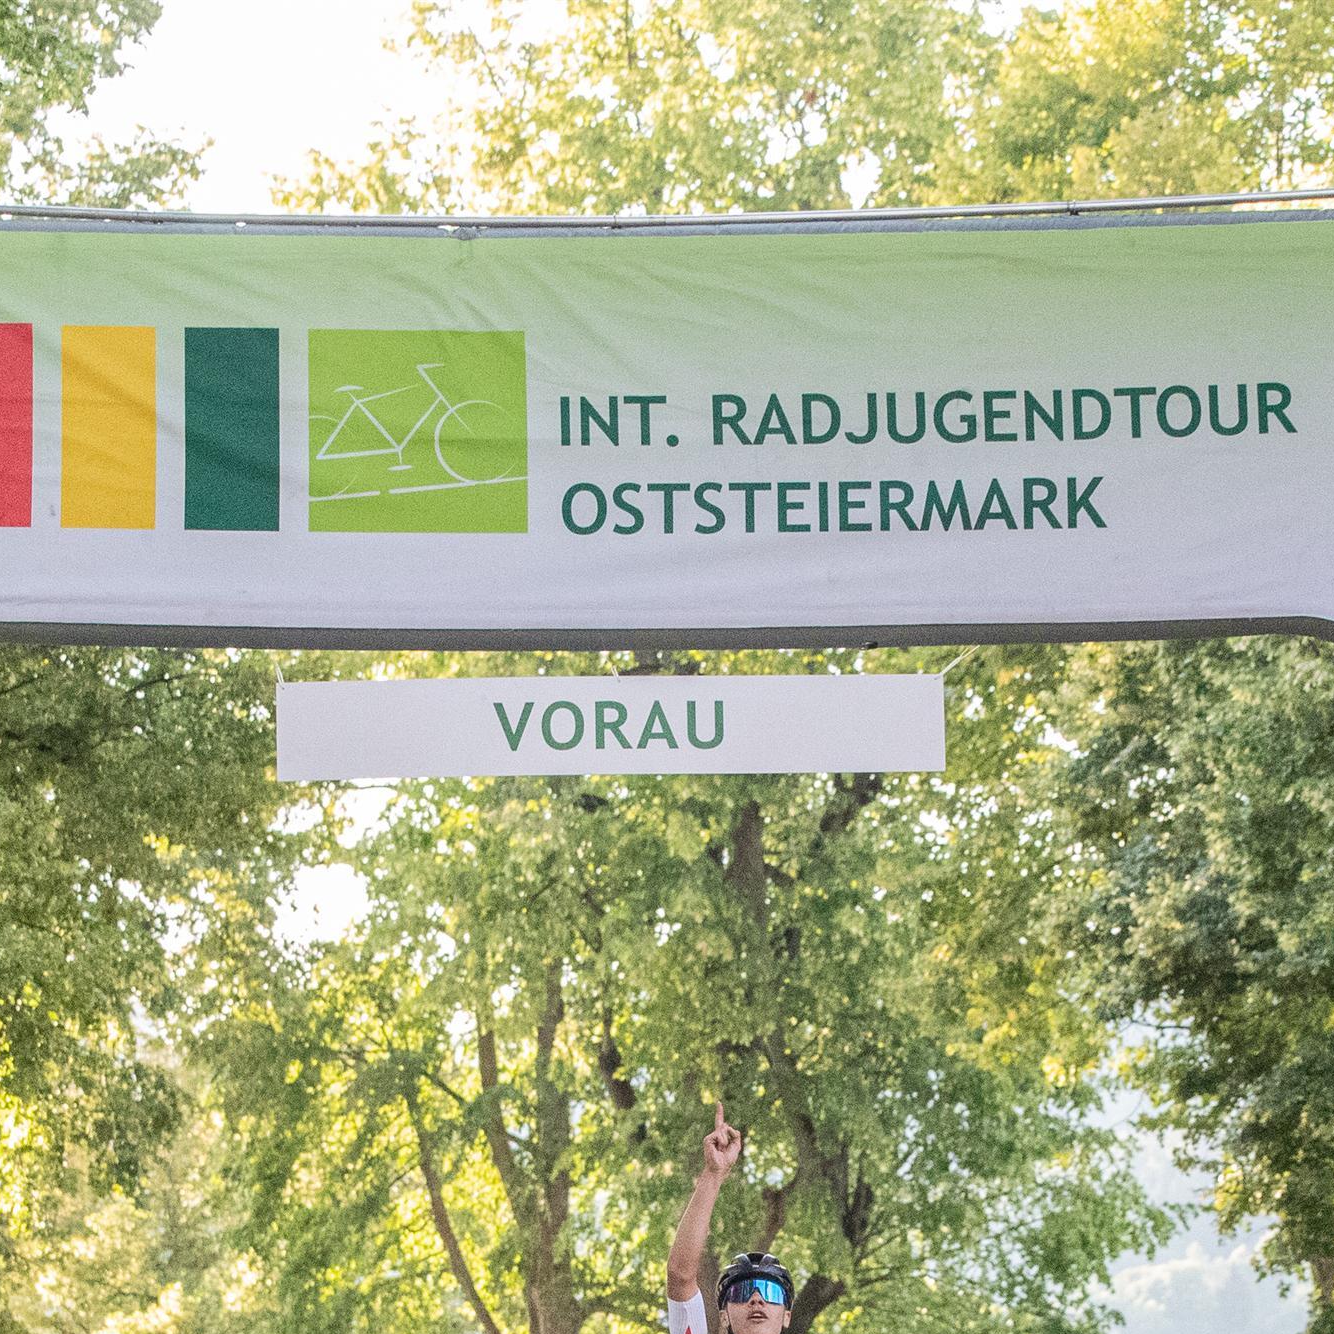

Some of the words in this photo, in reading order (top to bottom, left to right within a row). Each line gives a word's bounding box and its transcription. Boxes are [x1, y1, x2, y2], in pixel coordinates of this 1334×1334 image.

[560, 394, 679, 447] INT.
[712, 382, 1298, 447] RADJUGENDTOUR
[561, 476, 1107, 535] OSTSTEIERMARK
[493, 701, 727, 751] VORAU
